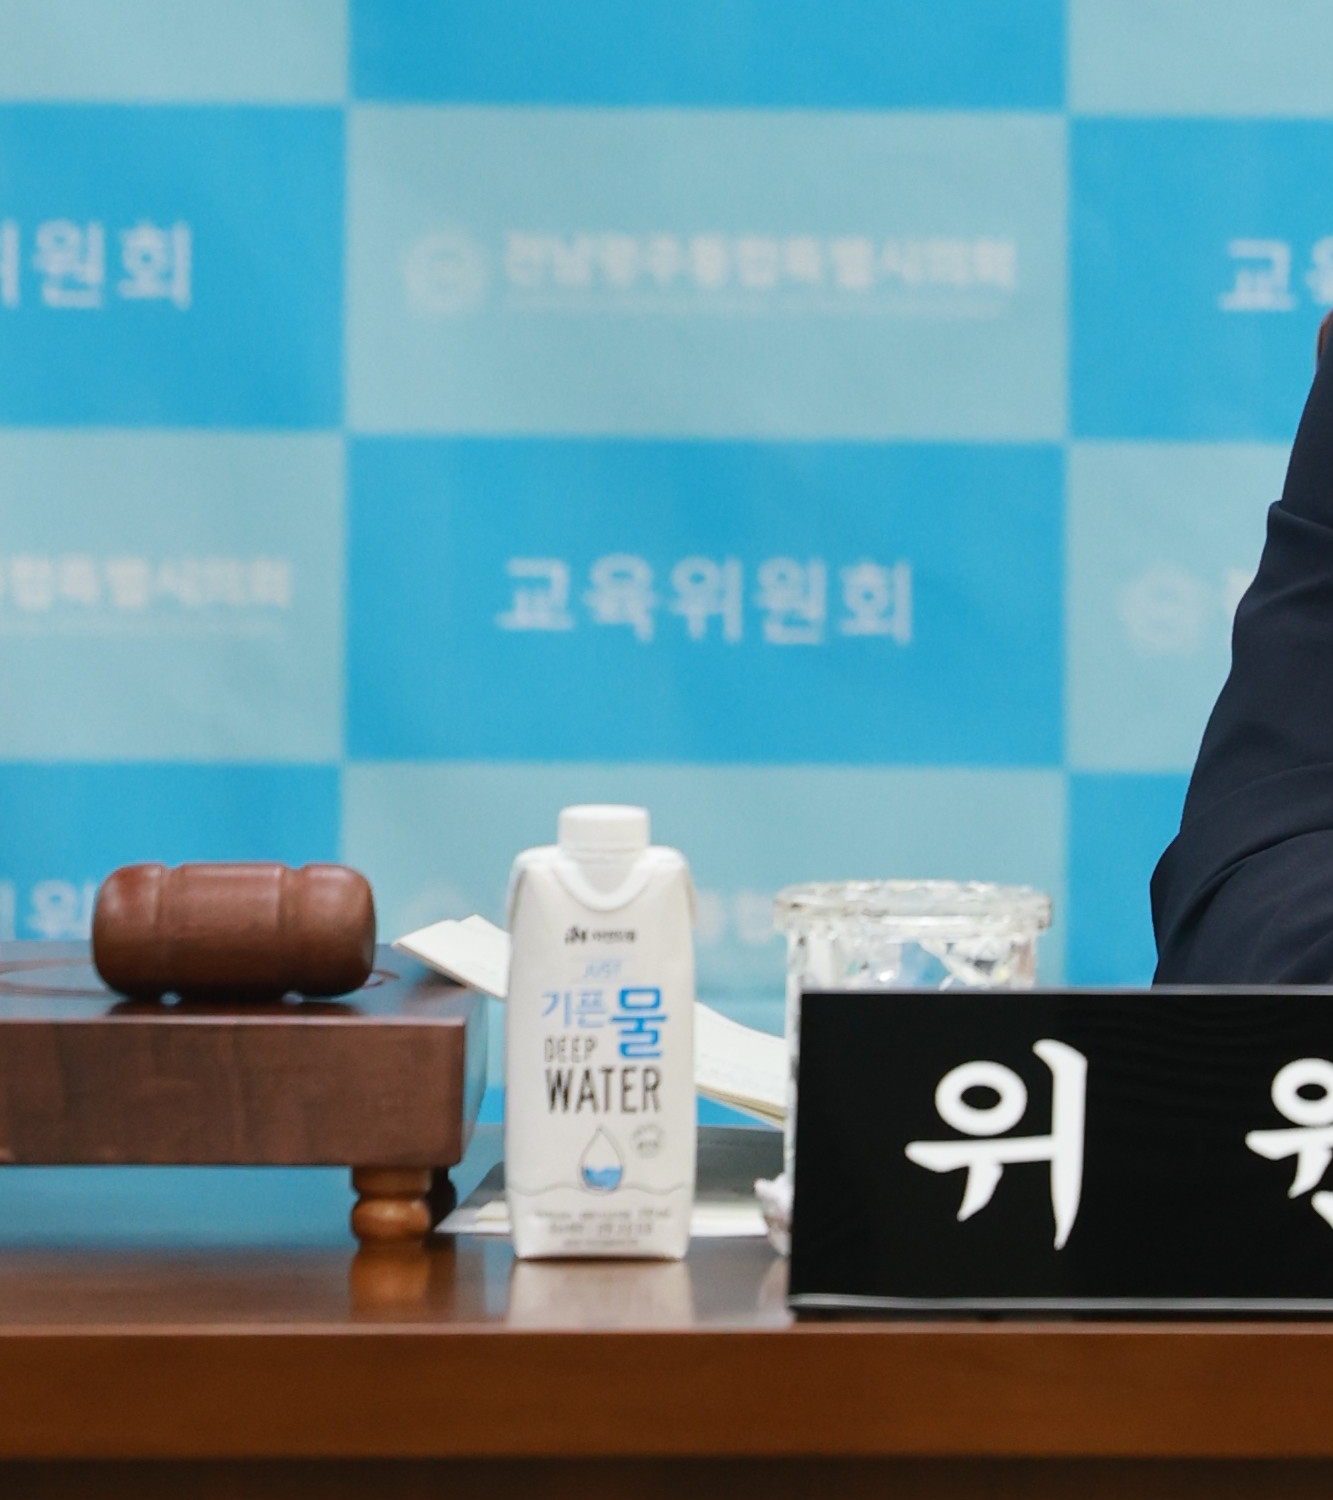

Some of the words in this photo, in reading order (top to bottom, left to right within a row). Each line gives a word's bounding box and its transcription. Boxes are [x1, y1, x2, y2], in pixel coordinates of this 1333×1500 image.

[0, 217, 195, 311] 원회
[497, 551, 915, 647] 교육위원회
[544, 1035, 597, 1063] DEEP
[610, 986, 667, 1060] 물
[546, 1066, 662, 1115] WATER
